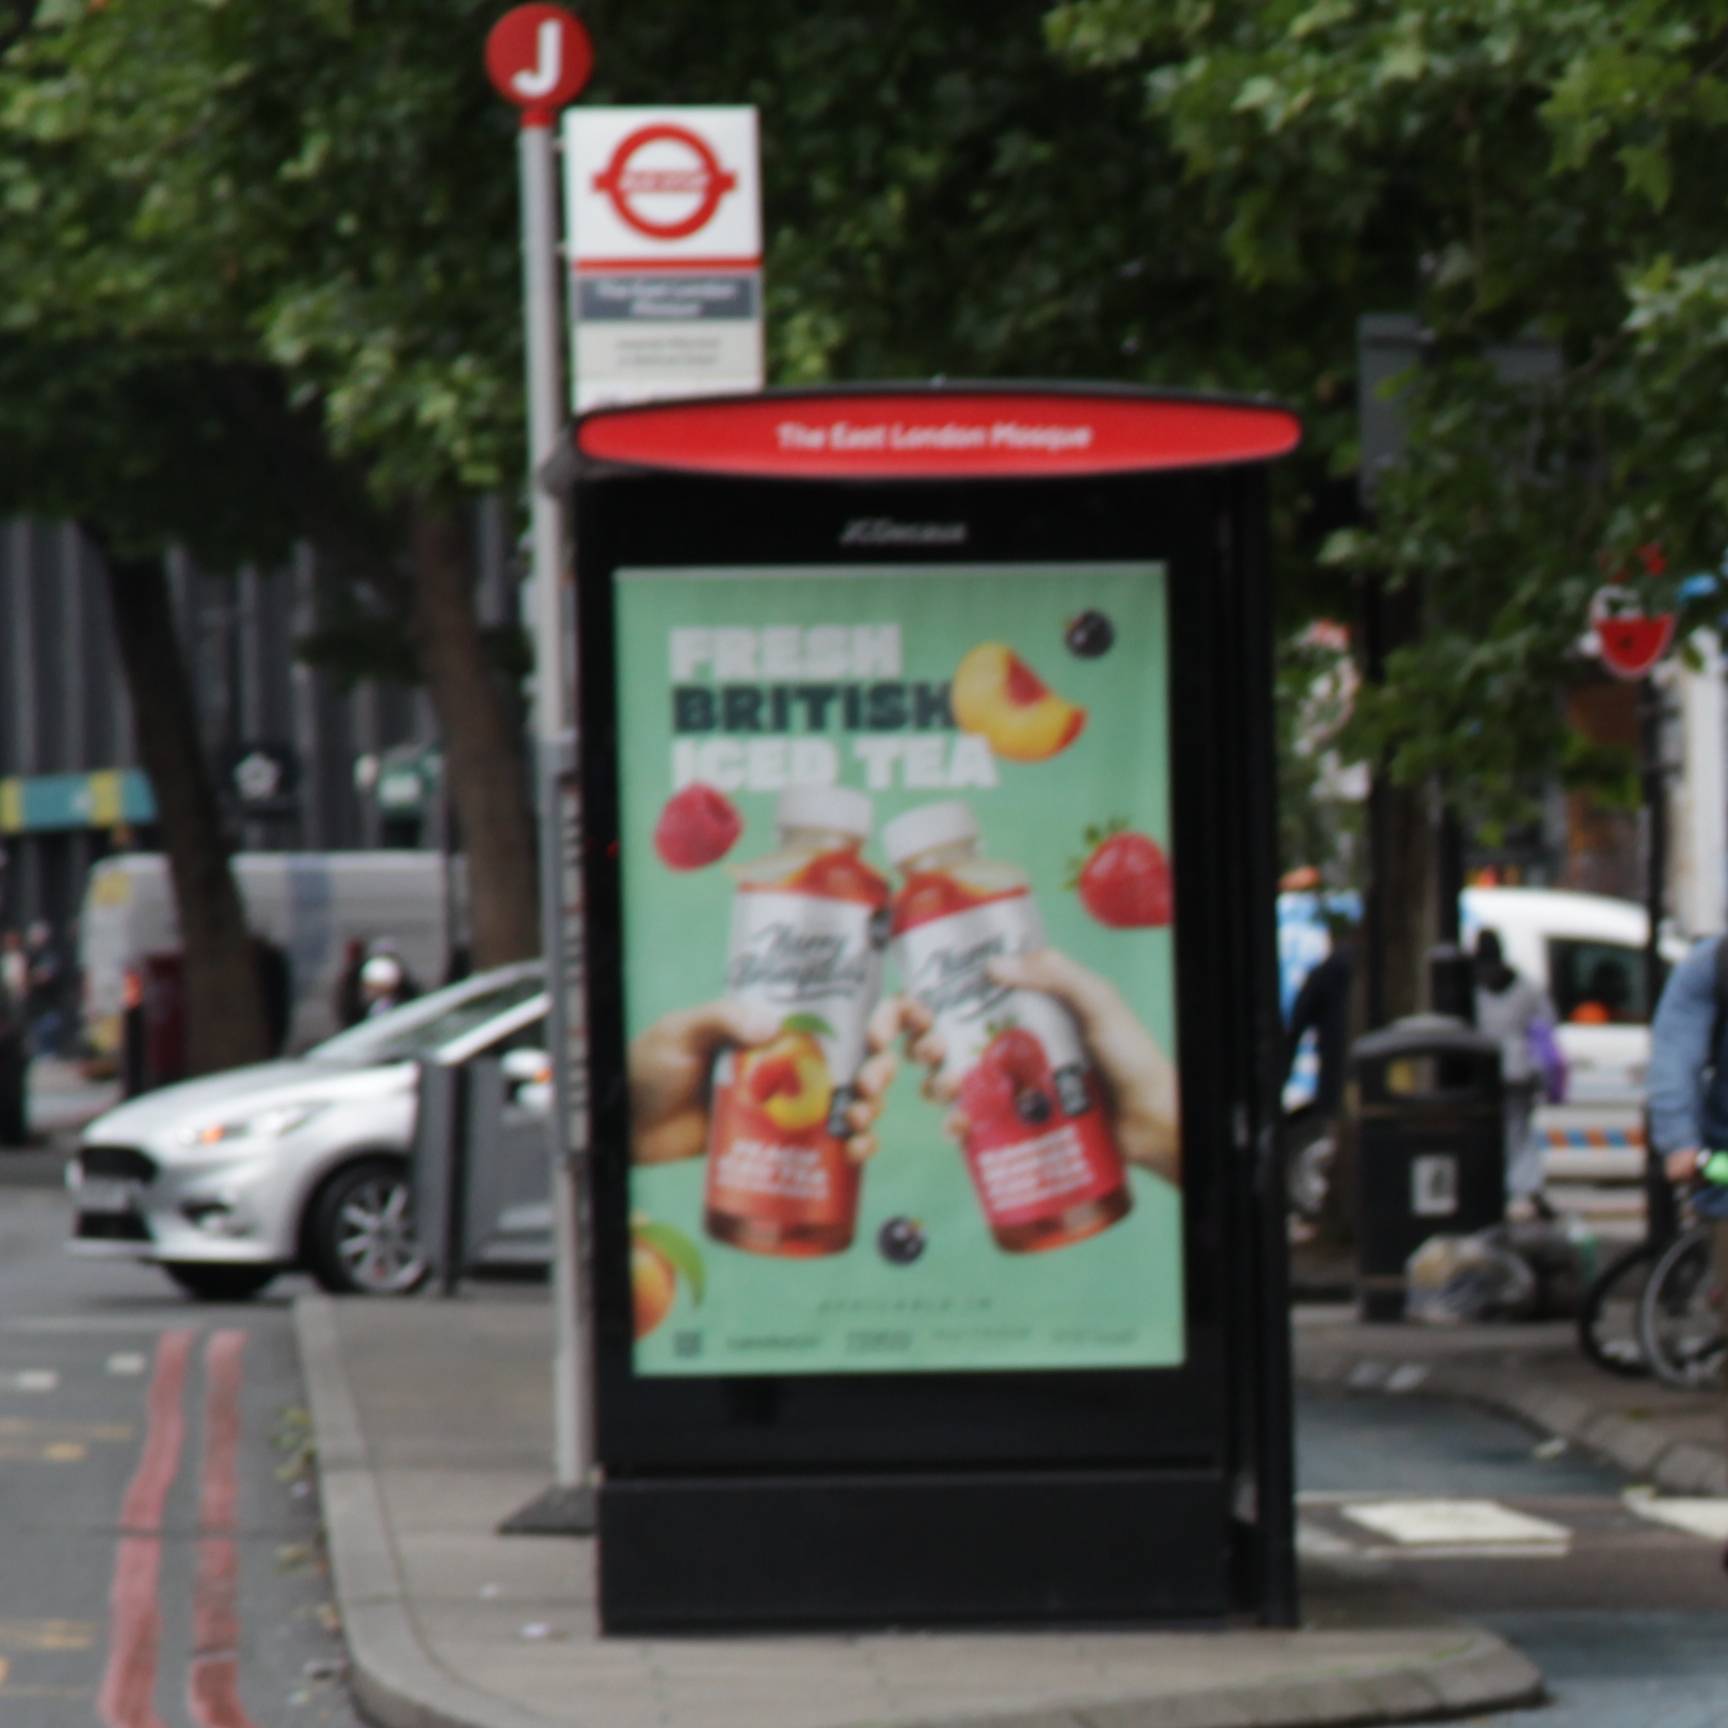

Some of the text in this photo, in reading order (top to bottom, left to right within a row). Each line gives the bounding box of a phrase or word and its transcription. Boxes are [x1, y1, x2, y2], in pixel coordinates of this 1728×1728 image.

[511, 18, 563, 98] J
[776, 420, 1094, 454] The East London Mosque
[669, 624, 903, 680] FRESH
[672, 680, 958, 734] BRITISH
[673, 734, 999, 791] ICED TEA
